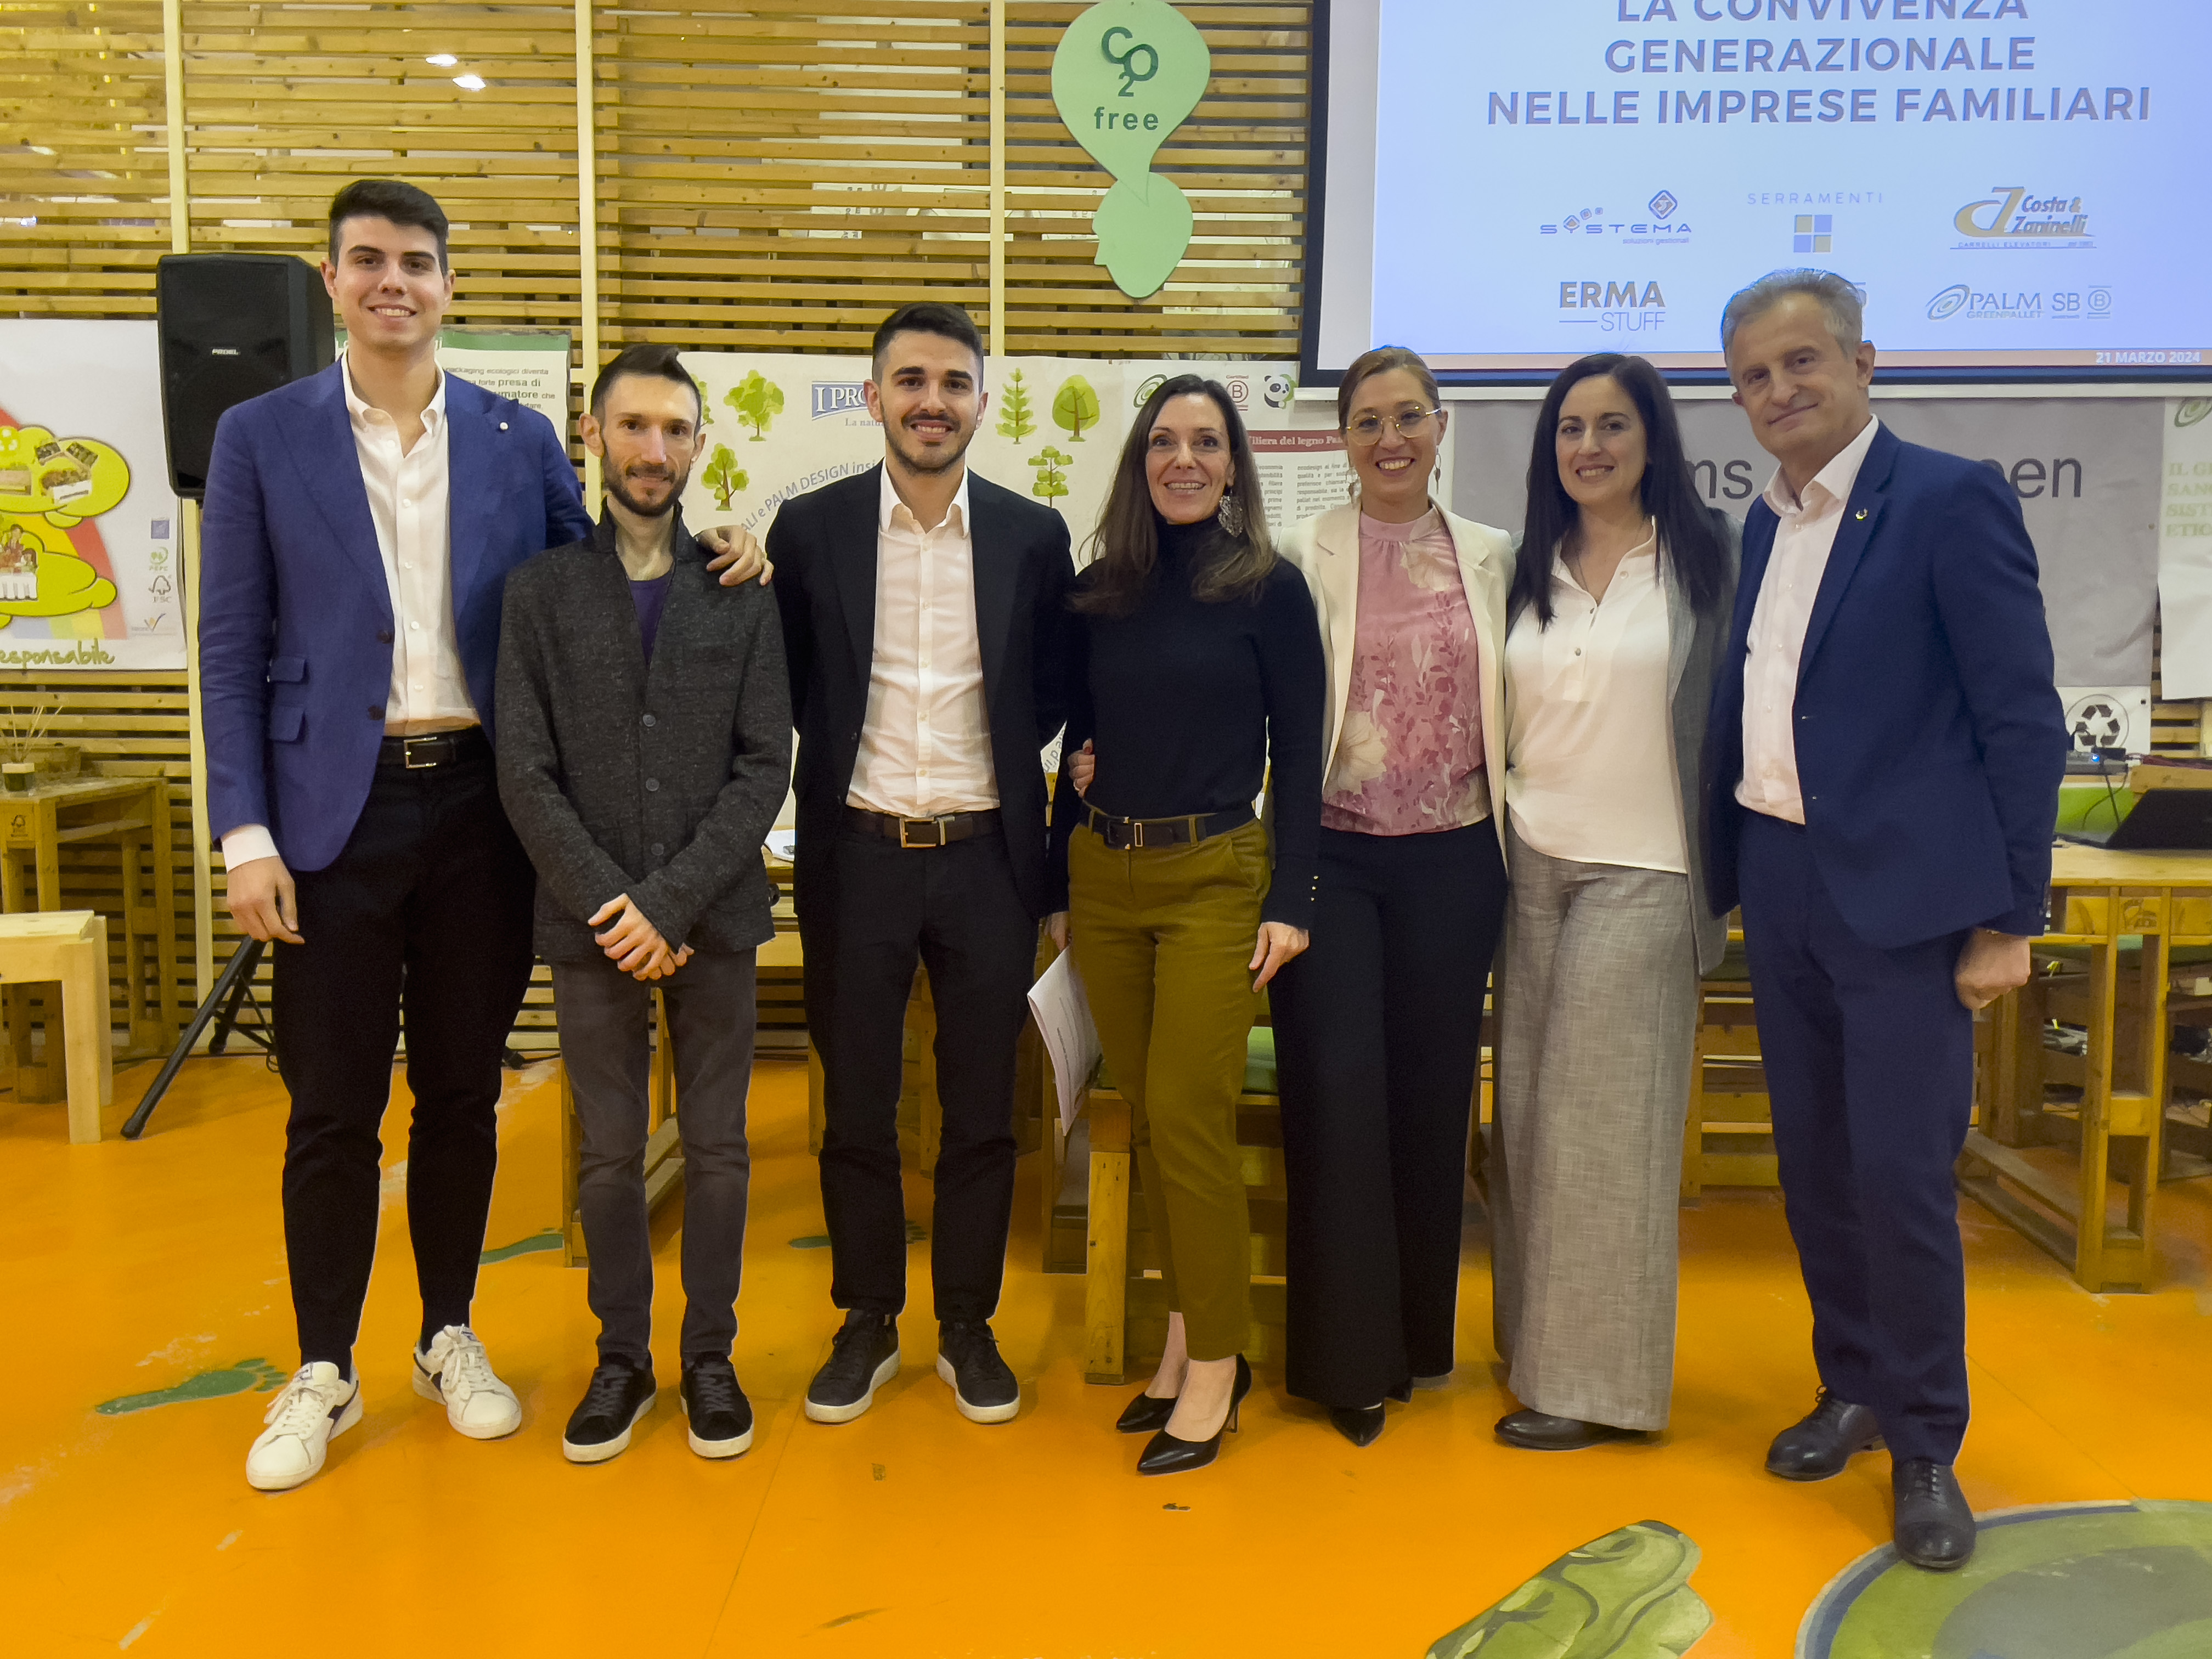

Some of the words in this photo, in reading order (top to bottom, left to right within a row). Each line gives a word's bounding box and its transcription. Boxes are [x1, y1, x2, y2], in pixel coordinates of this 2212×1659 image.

[1617, 0, 1677, 22] LA
[1694, 0, 2029, 21] CONVIVENZA
[1605, 37, 2035, 73] GENERAZIONALE
[1488, 91, 1640, 125] NELLE
[1658, 89, 1877, 124] IMPRESE
[1896, 87, 2151, 122] FAMILIARI
[1094, 106, 1159, 131] free
[1747, 191, 1883, 205] SERRAMENTI
[2022, 195, 2068, 213] Costa
[1559, 281, 1666, 308] ERMA
[1969, 292, 2042, 310] PALM
[2051, 292, 2081, 311] SB
[1600, 311, 1666, 331] STUFF
[2096, 352, 2111, 364] 21
[2115, 352, 2166, 364] MARZO
[2169, 351, 2201, 363] 2024
[498, 379, 528, 387] presa
[531, 379, 541, 387] di
[815, 387, 826, 412] I
[845, 418, 857, 426] La
[1280, 437, 1295, 445] del
[1298, 437, 1324, 447] legno
[758, 508, 766, 517] e
[764, 482, 799, 511] PALM
[799, 462, 849, 490] DESIGN
